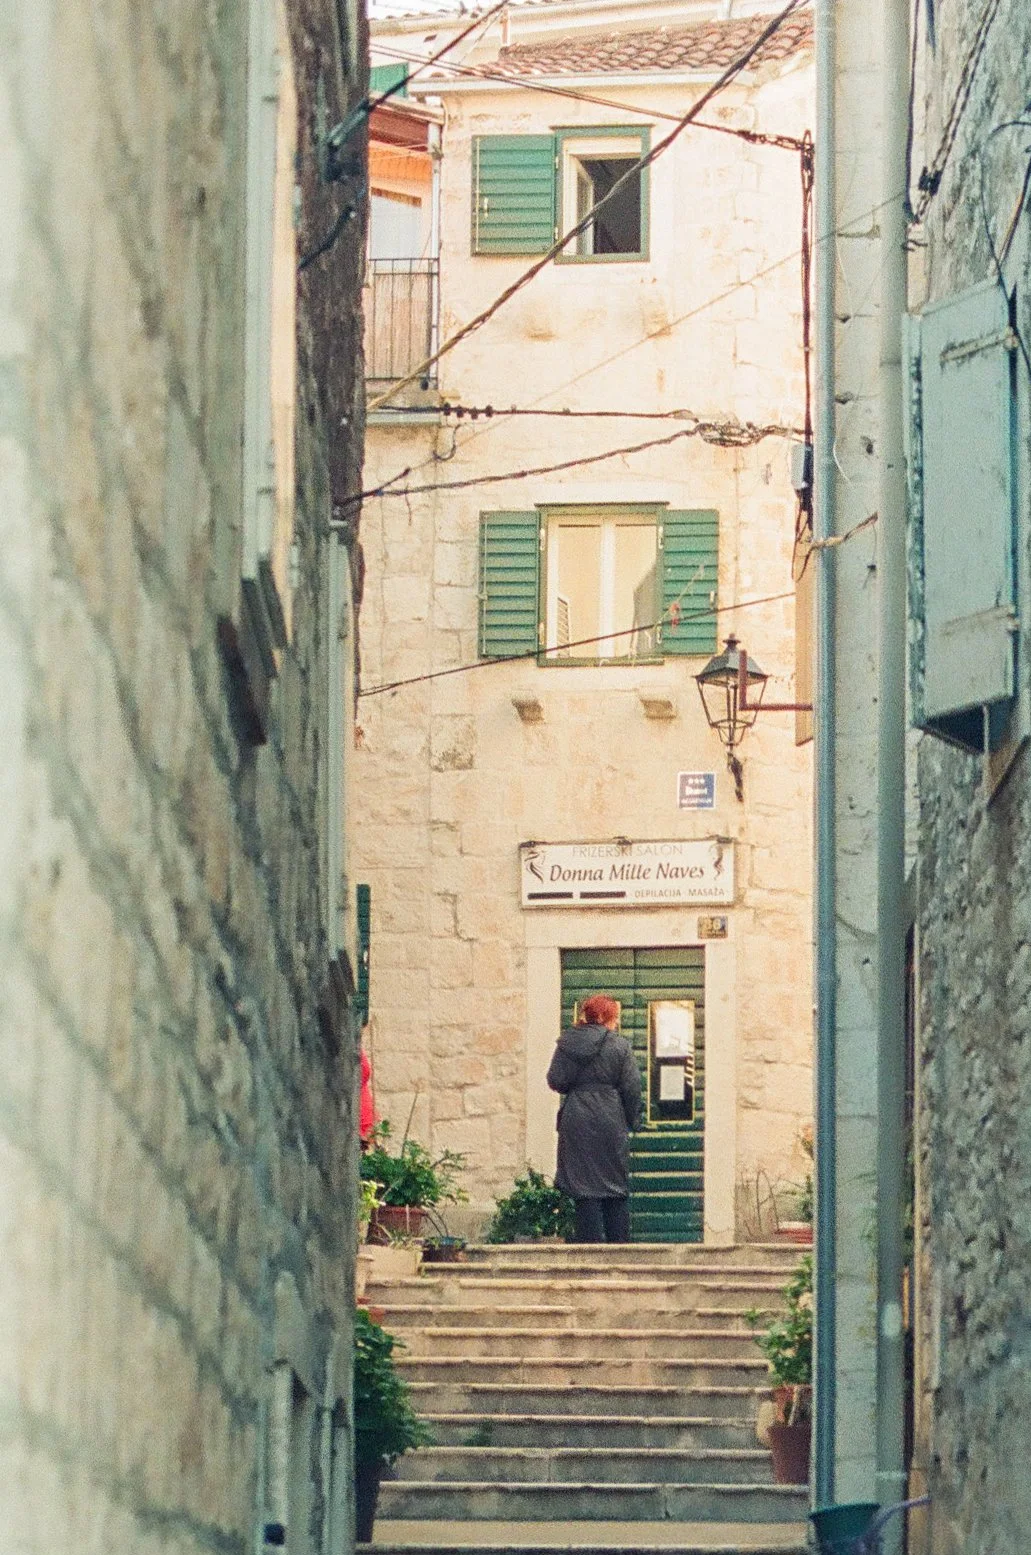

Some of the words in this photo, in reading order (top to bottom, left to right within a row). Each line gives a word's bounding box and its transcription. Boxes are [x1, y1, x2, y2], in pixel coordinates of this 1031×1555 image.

[572, 844, 633, 858] FRIZERSKI
[637, 844, 683, 857] SALON
[549, 864, 604, 883] Donna
[609, 863, 651, 881] Mille
[656, 862, 705, 880] Naves
[634, 888, 682, 899] DEPILACIJA
[688, 886, 725, 898] MASAŽA
